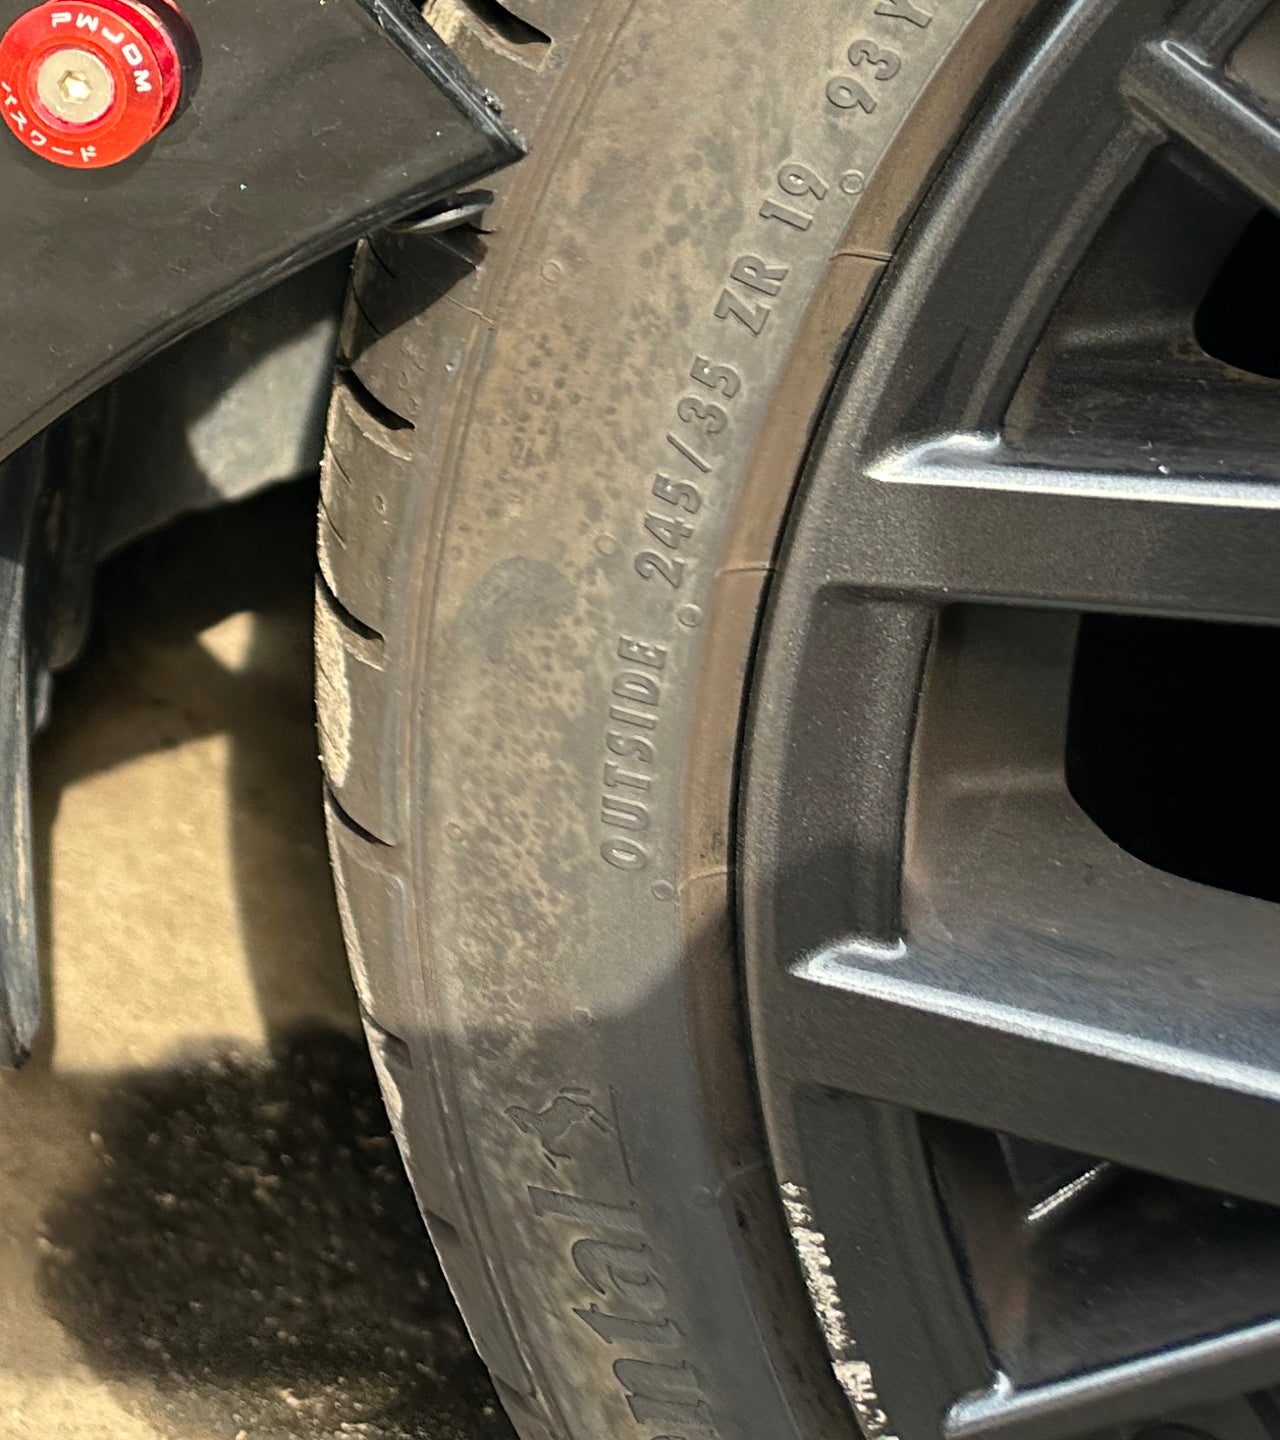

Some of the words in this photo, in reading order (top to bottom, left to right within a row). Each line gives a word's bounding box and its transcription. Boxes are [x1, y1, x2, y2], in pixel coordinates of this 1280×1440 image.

[50, 11, 153, 94] PWJDM
[759, 162, 829, 231] 19
[713, 253, 790, 335] ZR
[634, 354, 742, 589] 245/35
[600, 636, 669, 872] OUTSIDE
